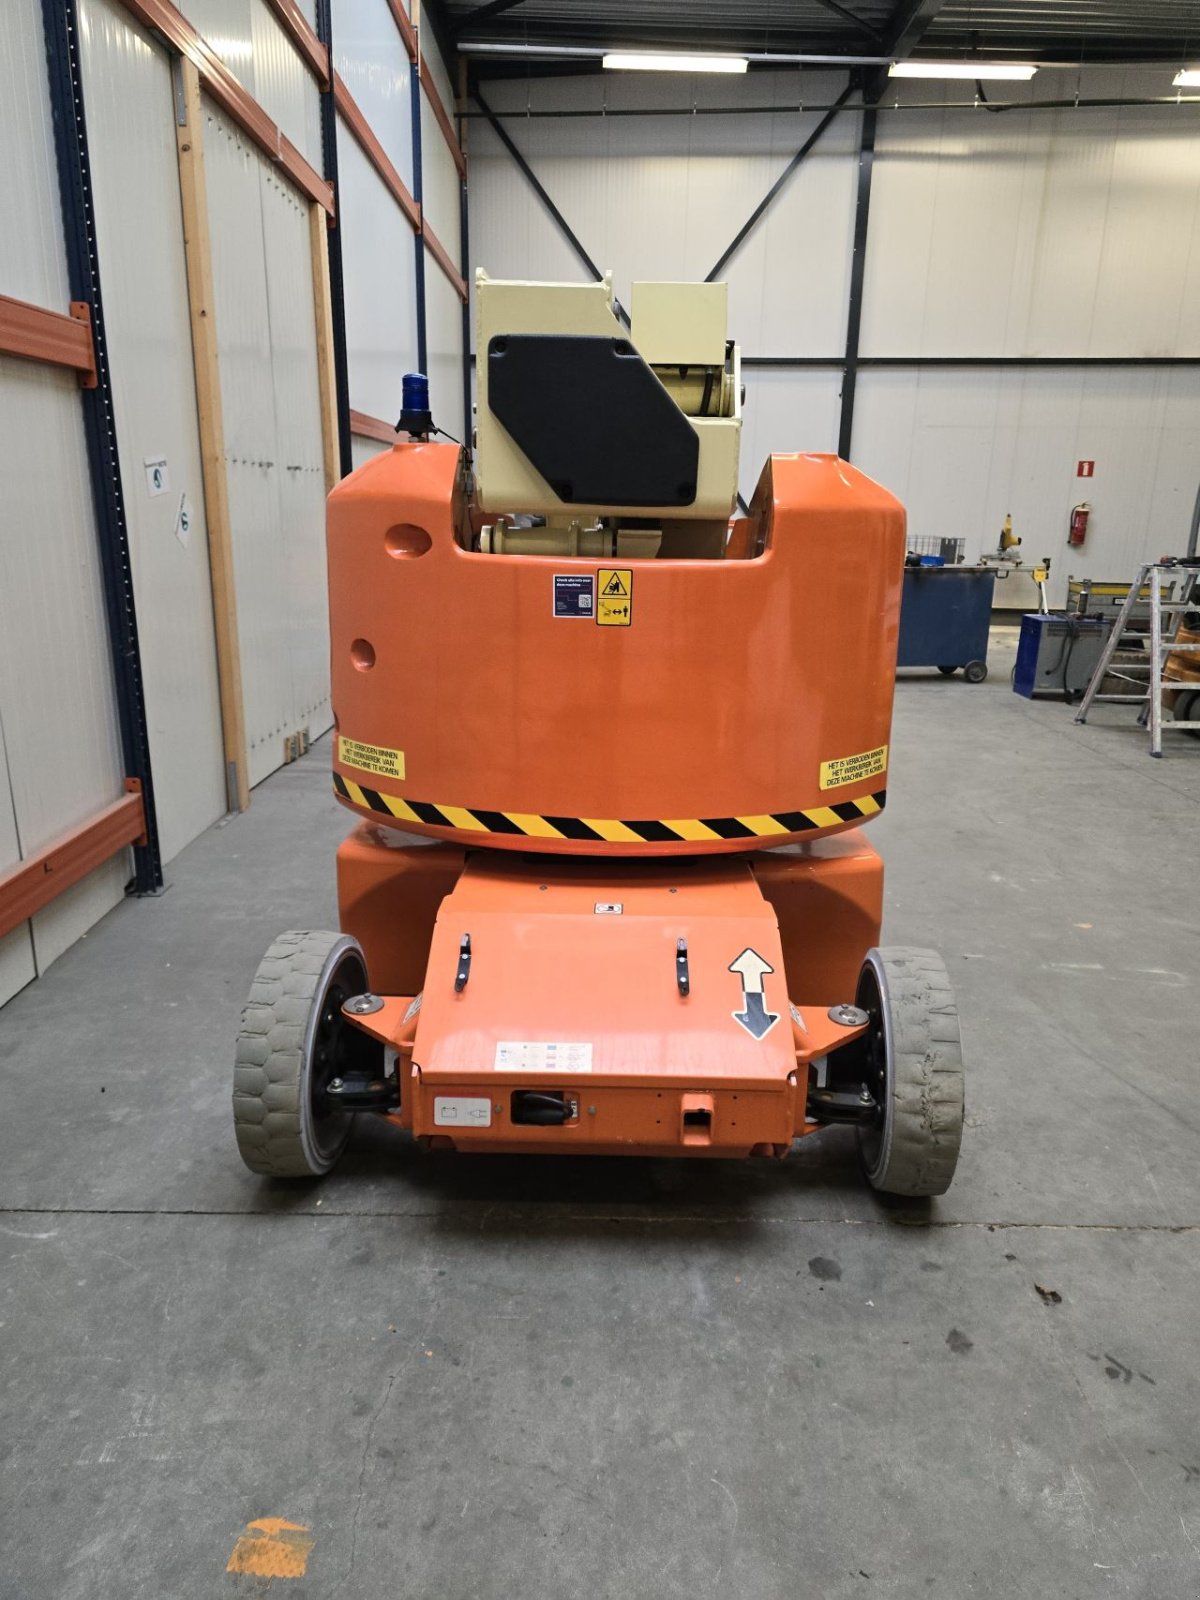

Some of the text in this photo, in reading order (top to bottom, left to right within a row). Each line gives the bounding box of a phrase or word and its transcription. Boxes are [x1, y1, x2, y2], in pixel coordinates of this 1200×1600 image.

[383, 758, 395, 767] VAN
[828, 762, 839, 770] HET
[846, 753, 870, 766] VERBODEN
[379, 766, 399, 776] KOMEN
[832, 769, 843, 777] HET
[827, 777, 840, 786] DEZE
[841, 772, 863, 782] MACHINE
